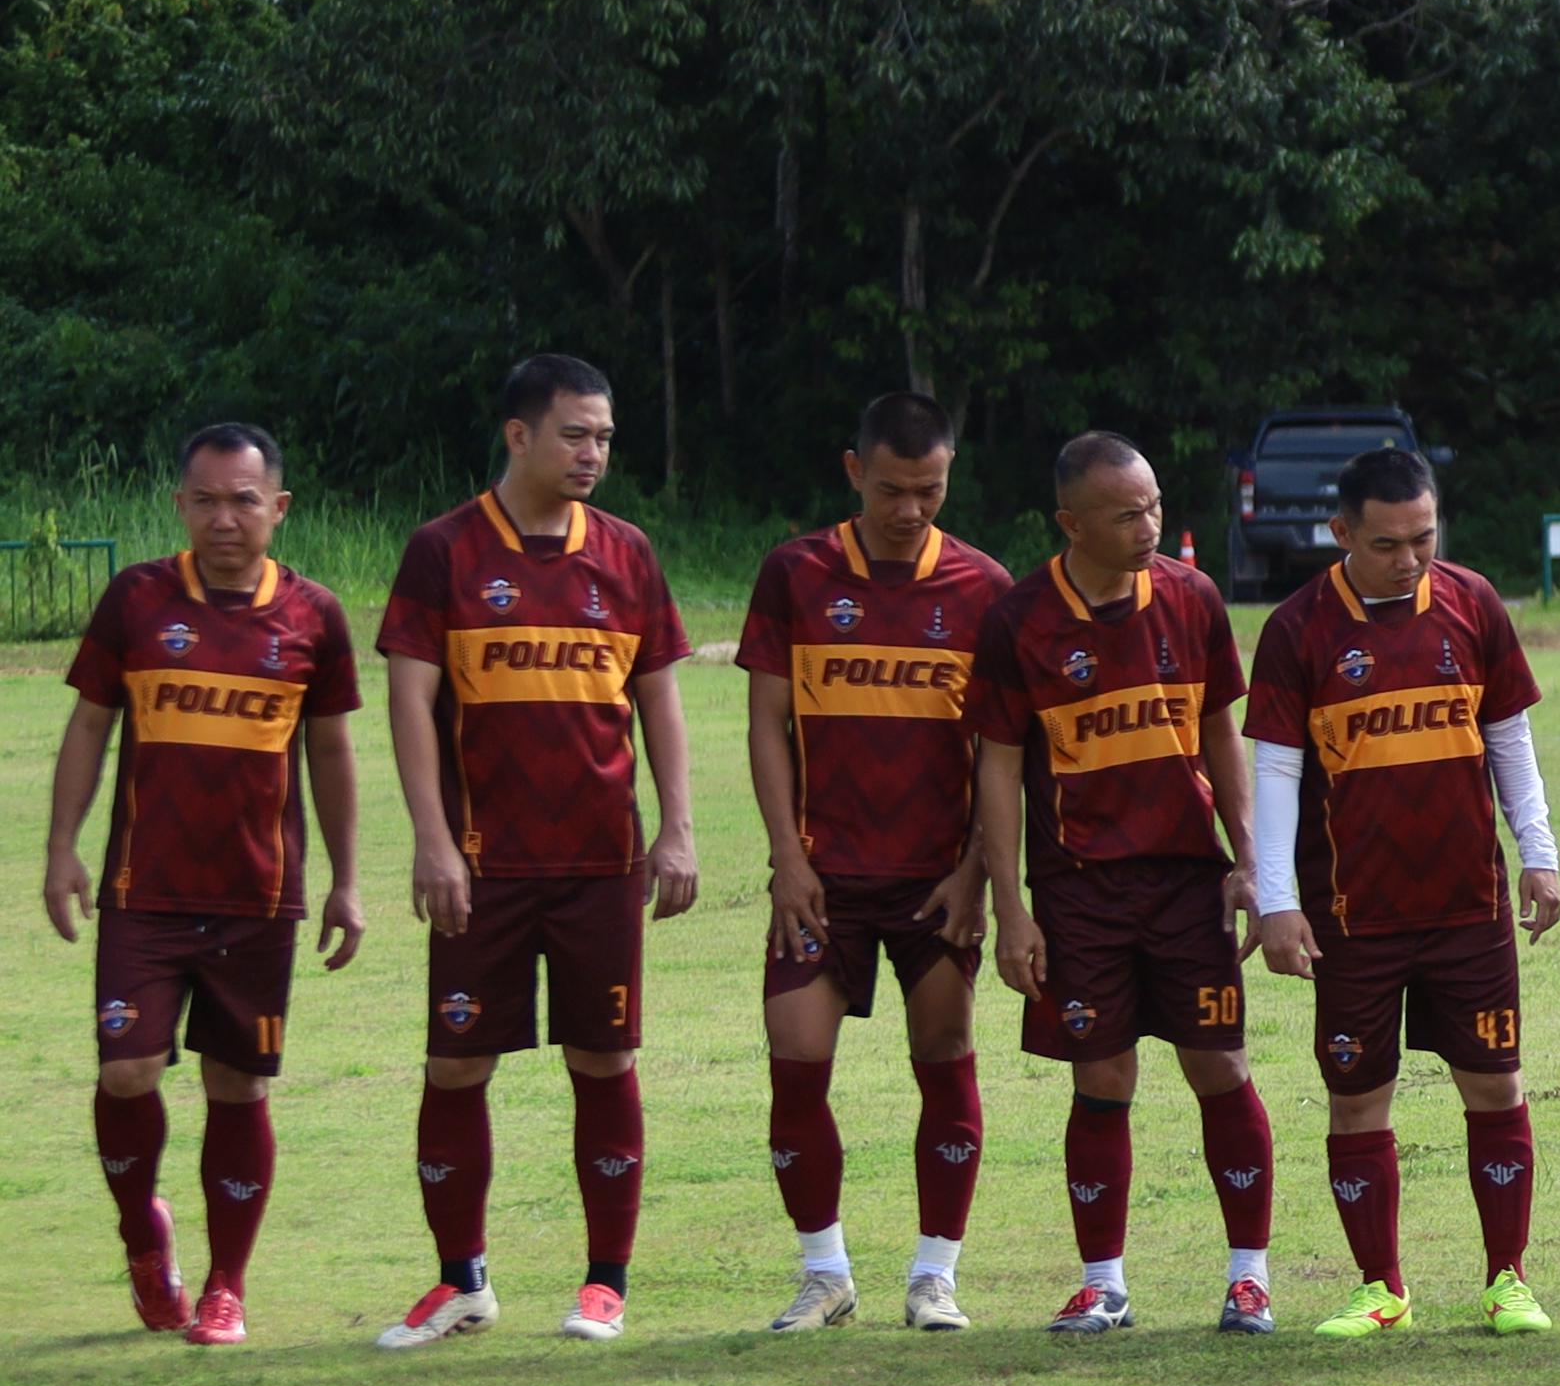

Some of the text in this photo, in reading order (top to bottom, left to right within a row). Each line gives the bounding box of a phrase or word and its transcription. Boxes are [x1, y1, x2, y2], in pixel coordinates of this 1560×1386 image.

[482, 641, 615, 672] POLICE
[822, 658, 958, 690] POLICE
[155, 682, 284, 721] POLICE
[1076, 697, 1189, 742] POLICE
[1347, 698, 1471, 742] POLICE
[609, 984, 629, 1027] 3
[1198, 985, 1239, 1026] 50
[256, 1015, 284, 1055] 11
[1476, 1009, 1517, 1049] 43
